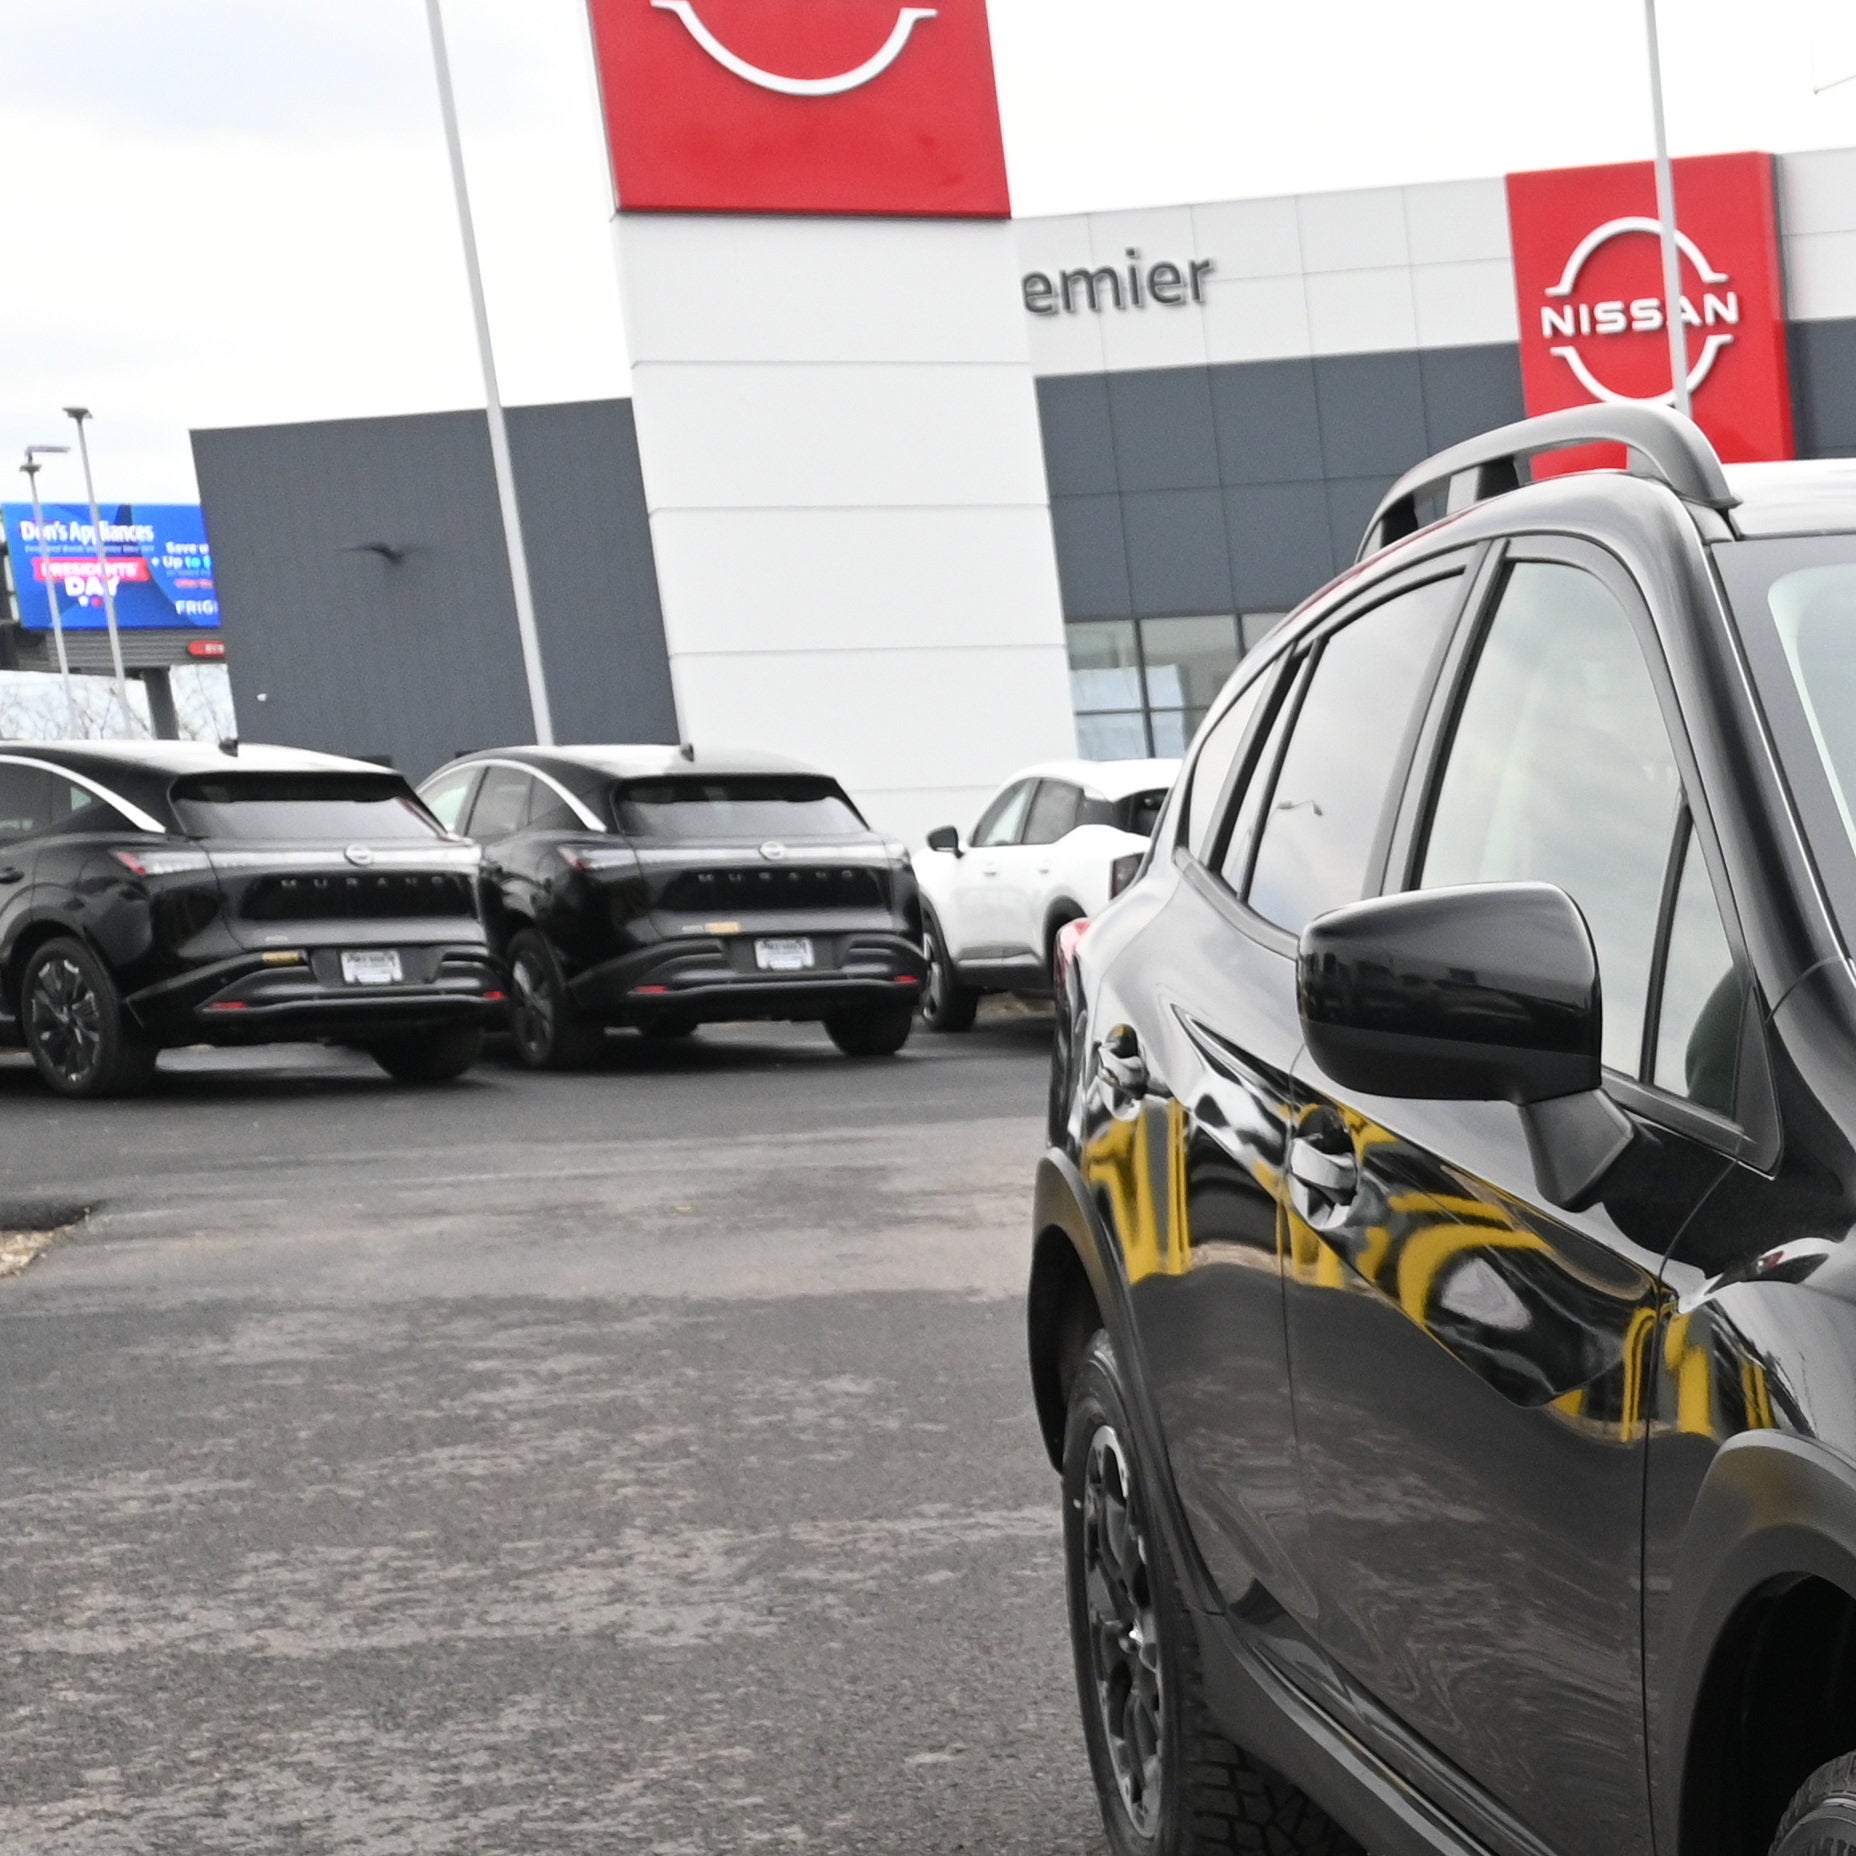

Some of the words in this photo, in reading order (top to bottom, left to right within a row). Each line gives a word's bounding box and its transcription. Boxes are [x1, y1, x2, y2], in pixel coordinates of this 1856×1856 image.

[1021, 248, 1214, 315] emier
[1540, 291, 1740, 338] NISSAN
[64, 576, 120, 597] DAY
